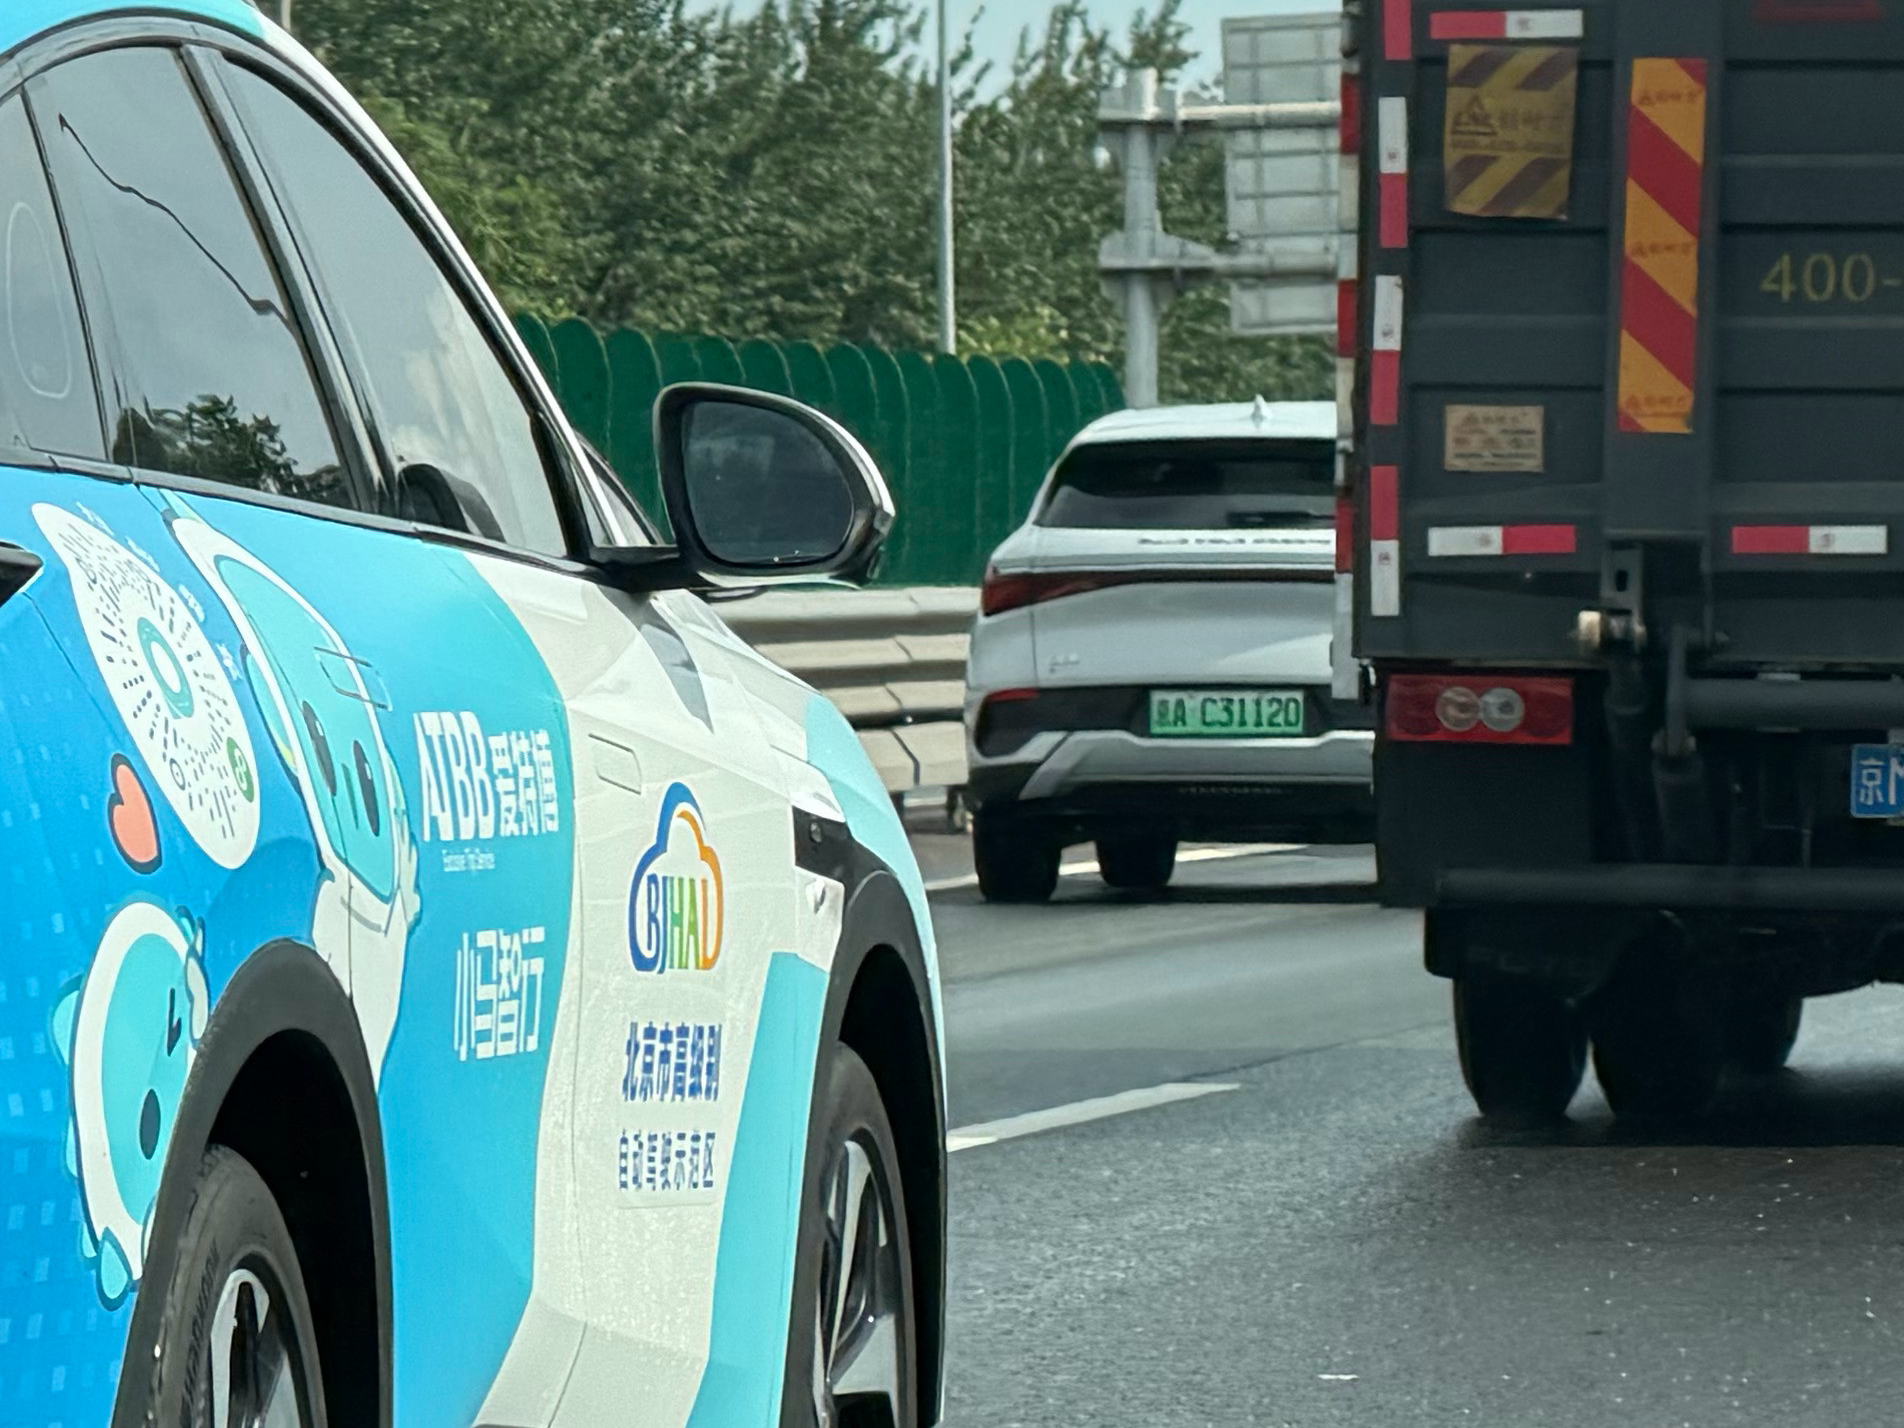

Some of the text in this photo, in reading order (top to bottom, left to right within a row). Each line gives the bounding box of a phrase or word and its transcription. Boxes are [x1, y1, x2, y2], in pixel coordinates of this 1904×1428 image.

[413, 711, 495, 842] ATBB
[454, 926, 545, 1062] 小马智行
[622, 1021, 722, 1102] 北京市高级别
